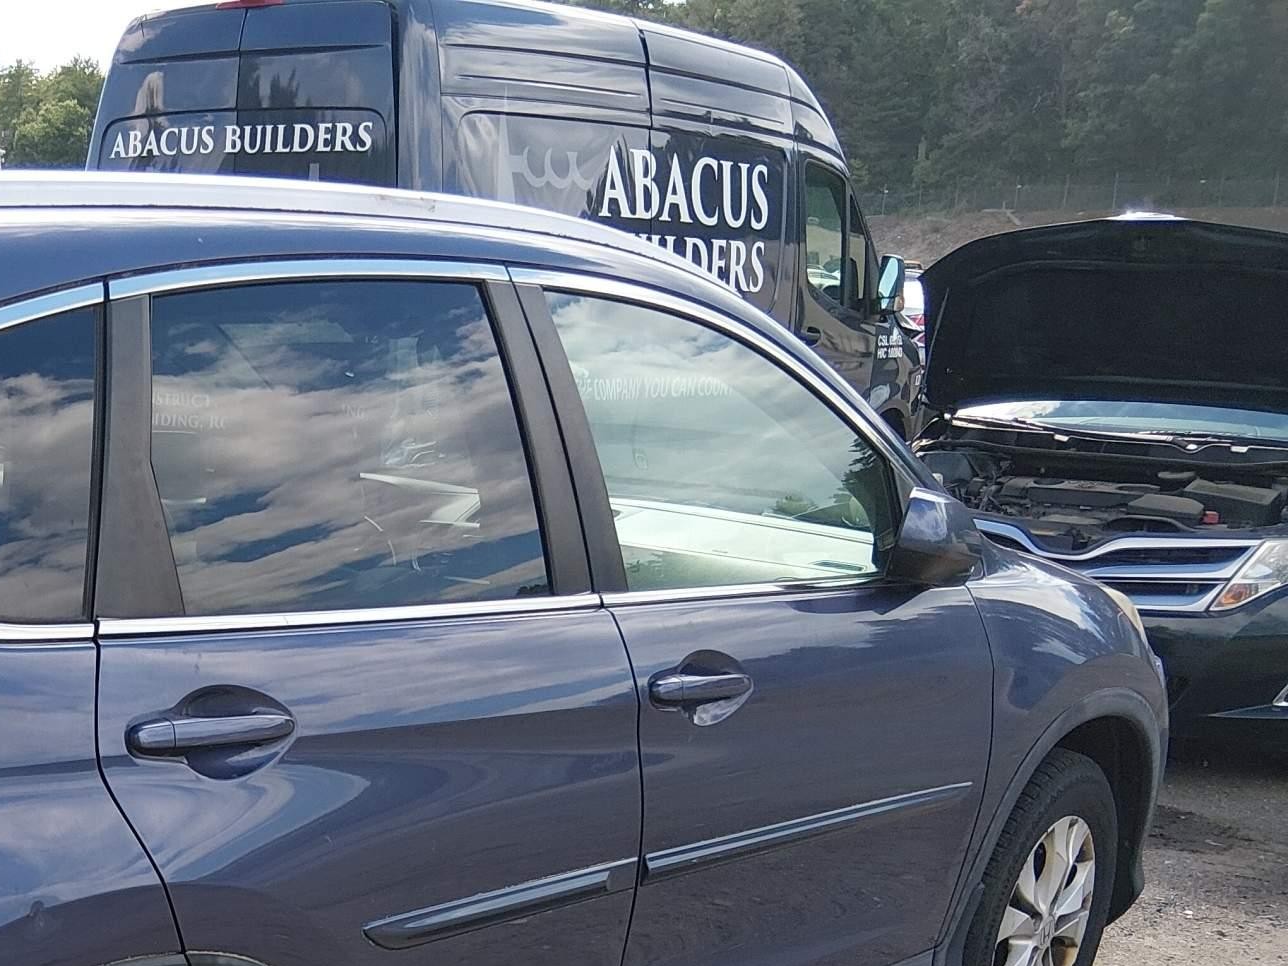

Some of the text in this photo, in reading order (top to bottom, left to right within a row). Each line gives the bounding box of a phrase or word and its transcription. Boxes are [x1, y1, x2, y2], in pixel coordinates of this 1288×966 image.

[109, 121, 373, 159] ABACUS BUILDERS
[598, 144, 769, 231] ABACUS
[594, 377, 641, 401] COMPANY
[643, 376, 668, 399] YOU
[670, 375, 697, 398] CAN
